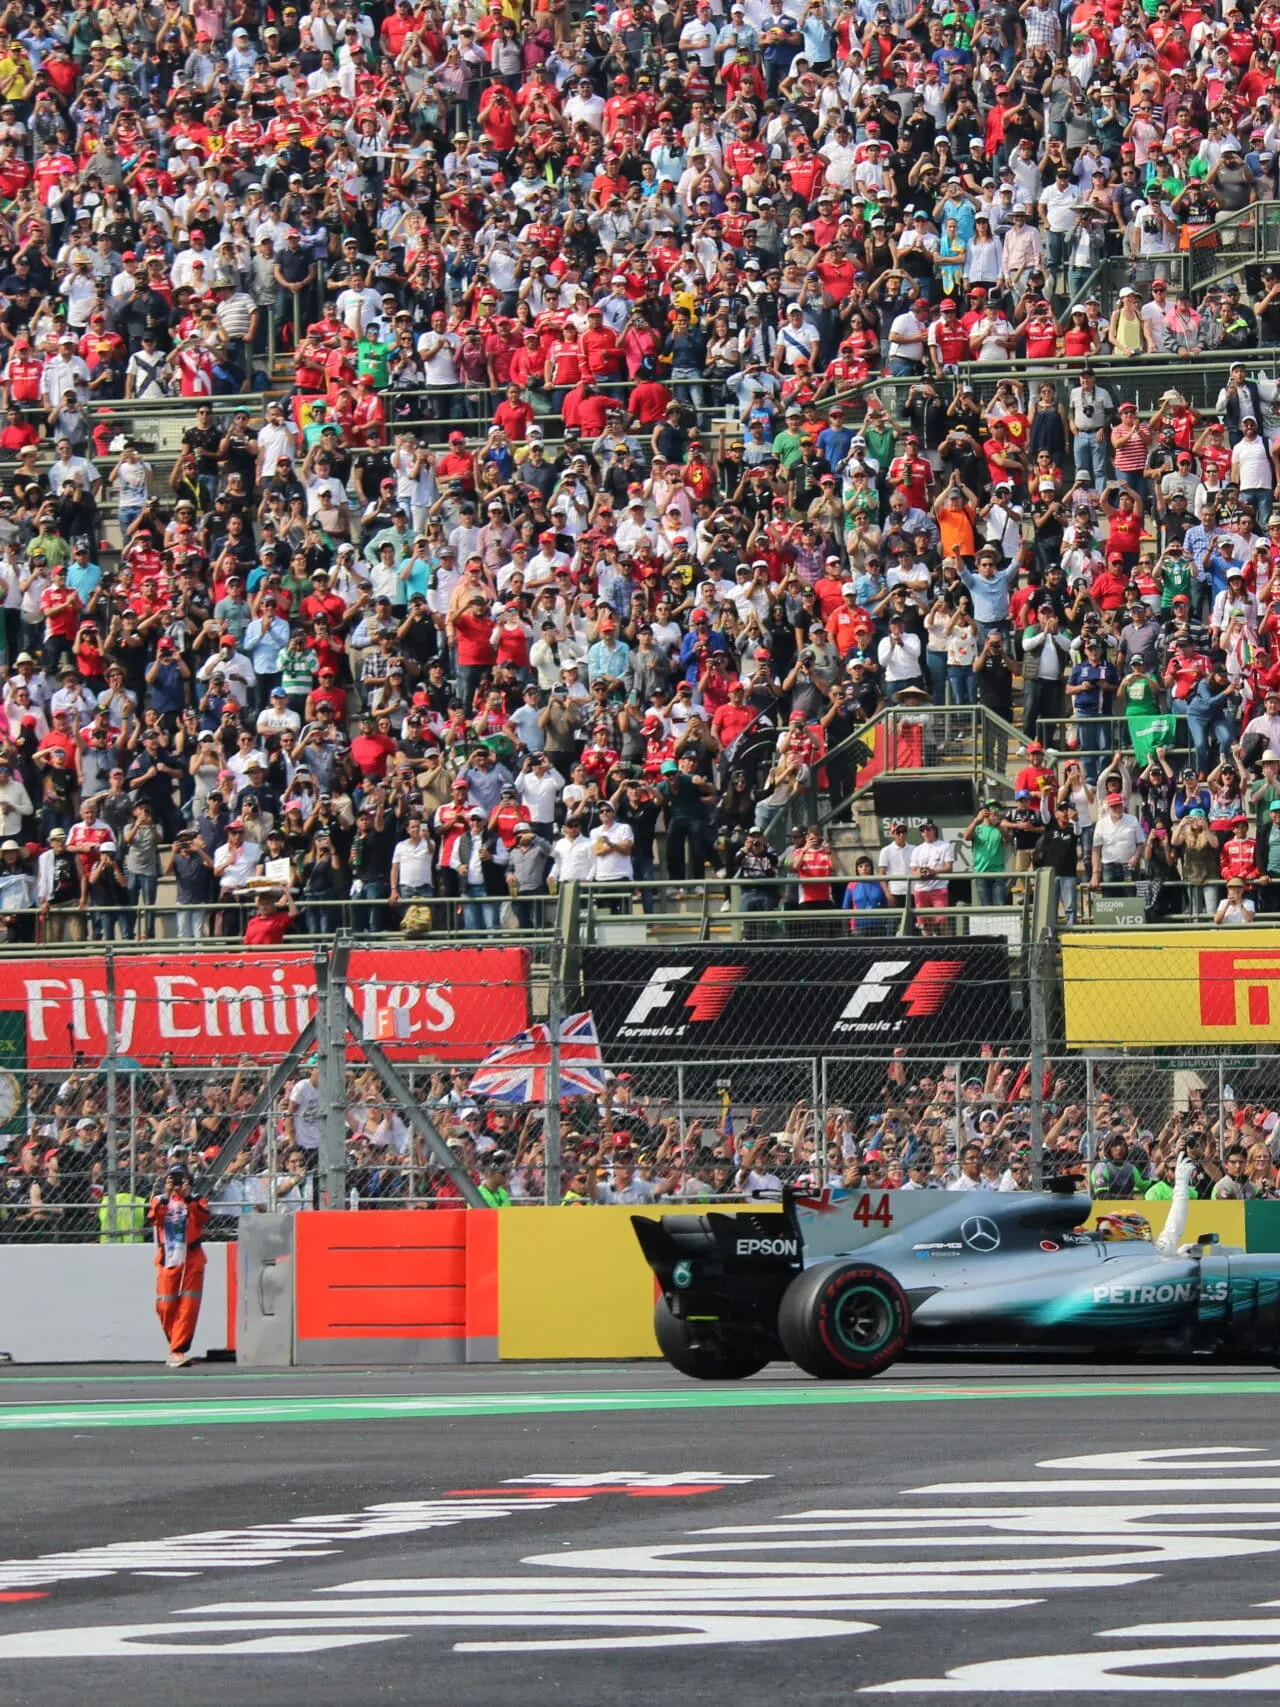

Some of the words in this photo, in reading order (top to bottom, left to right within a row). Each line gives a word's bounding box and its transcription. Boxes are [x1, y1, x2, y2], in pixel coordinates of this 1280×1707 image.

[882, 817, 928, 829] SALID
[23, 978, 137, 1053] Fly
[153, 968, 456, 1038] Emirtes
[616, 1023, 673, 1038] Formula
[833, 1019, 891, 1033] Formula
[853, 1193, 893, 1228] 44
[736, 1239, 797, 1255] EPSON
